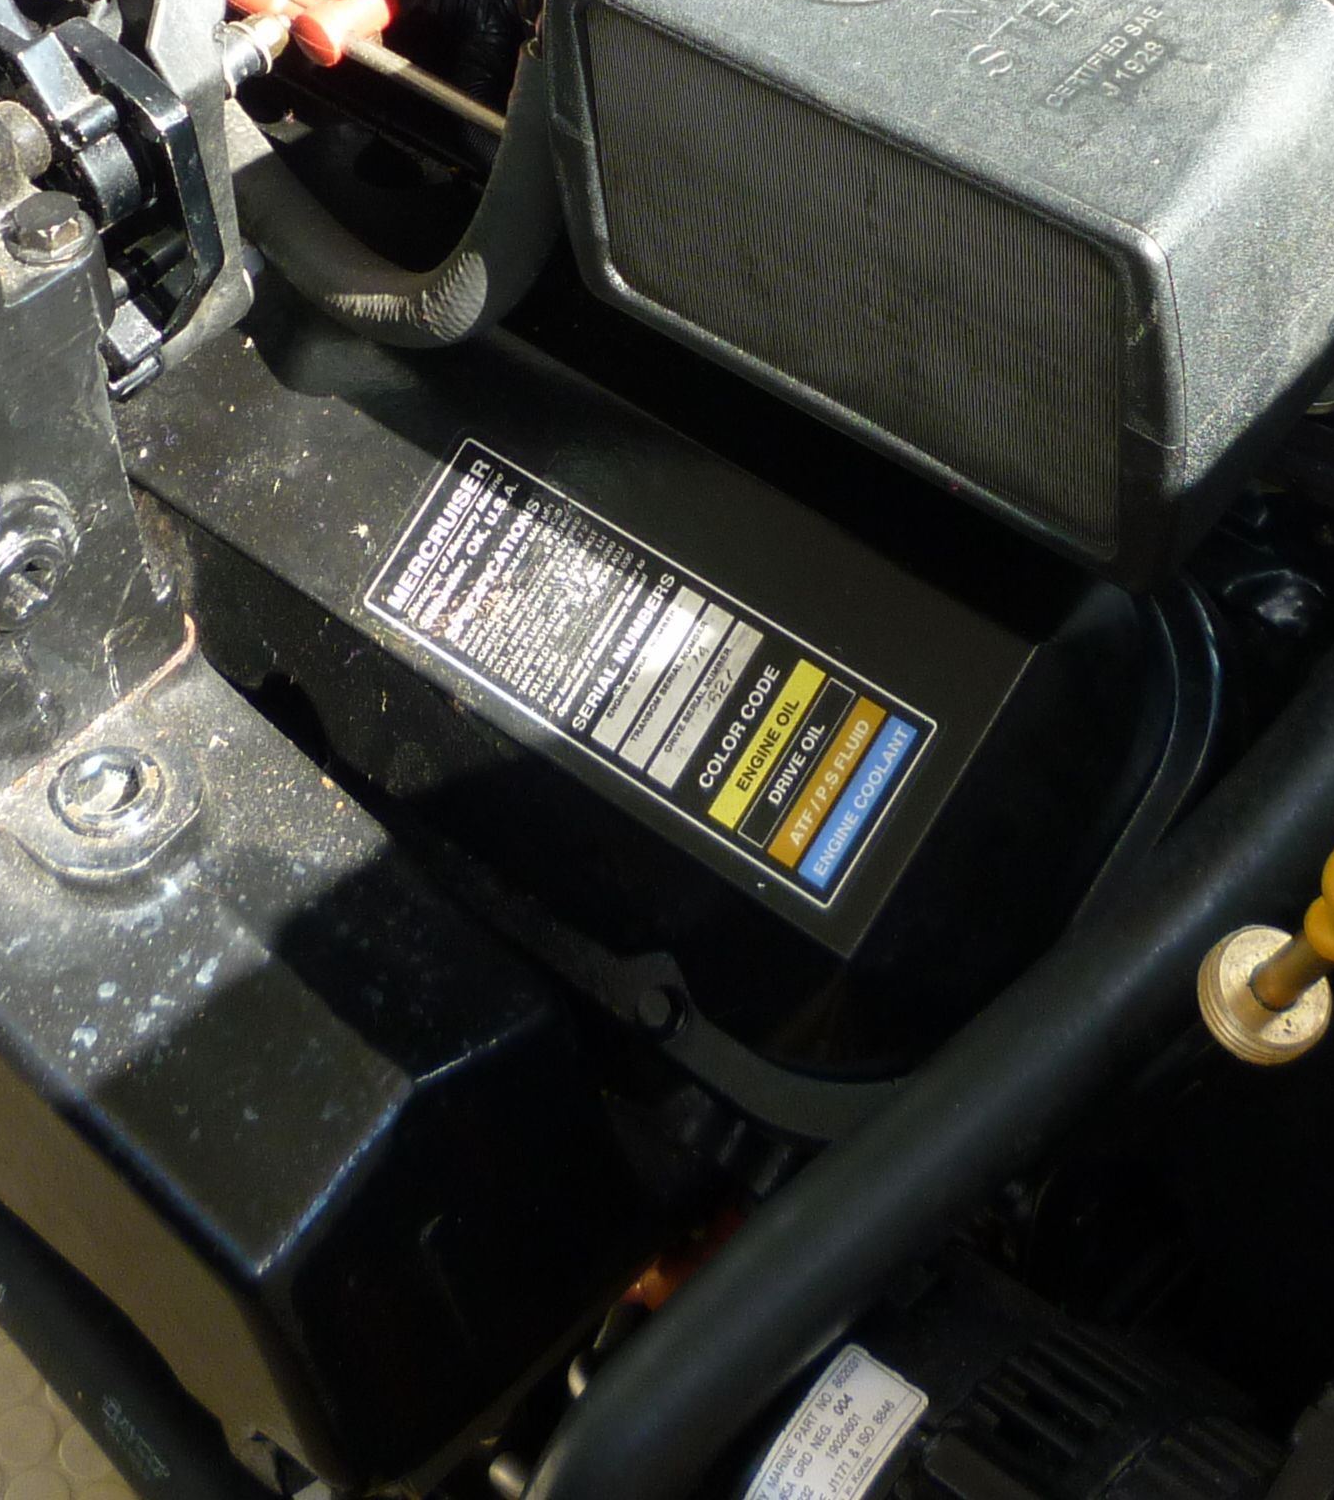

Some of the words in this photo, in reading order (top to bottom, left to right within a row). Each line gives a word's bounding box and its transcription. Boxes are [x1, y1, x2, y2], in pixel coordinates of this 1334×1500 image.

[1044, 31, 1131, 109] CERTIFIED
[1121, 2, 1165, 45] SAE
[386, 457, 490, 610] MERCRUISER
[406, 571, 442, 620] Division
[435, 556, 452, 573] of
[444, 510, 480, 560] Mercury
[474, 471, 505, 511] Marine
[465, 525, 490, 556] OK,
[484, 478, 519, 526] U.S.A.
[444, 497, 541, 642] SPECIFICATIONS
[570, 662, 620, 732] SERIAL
[612, 571, 676, 664] NUMBERS
[606, 684, 630, 718] ENGINE
[630, 695, 662, 742] TRANSOM
[659, 661, 683, 695] SERIAL
[664, 723, 685, 753] DRIVE
[682, 689, 705, 723] SERIAL
[703, 647, 731, 688] NUMBER
[697, 720, 745, 789] COLOR
[738, 664, 779, 721] CODE
[736, 727, 780, 791] ENGINE
[774, 696, 799, 727] OIL
[767, 751, 806, 805] DRIVE
[799, 720, 825, 752] OIL
[788, 809, 816, 845] ATF
[814, 769, 839, 801] P.S
[833, 718, 870, 770] FLUID
[812, 810, 858, 876] ENGINE
[852, 725, 908, 810] COOLANT
[764, 1443, 798, 1488] MARINE
[793, 1411, 818, 1442] PART
[792, 1452, 813, 1478] GRD
[833, 1393, 852, 1416] 004
[826, 1460, 851, 1492] J1171
[847, 1447, 860, 1459] &
[856, 1425, 874, 1446] ISO
[872, 1398, 894, 1425] 8846
[850, 1455, 872, 1482] Korea
